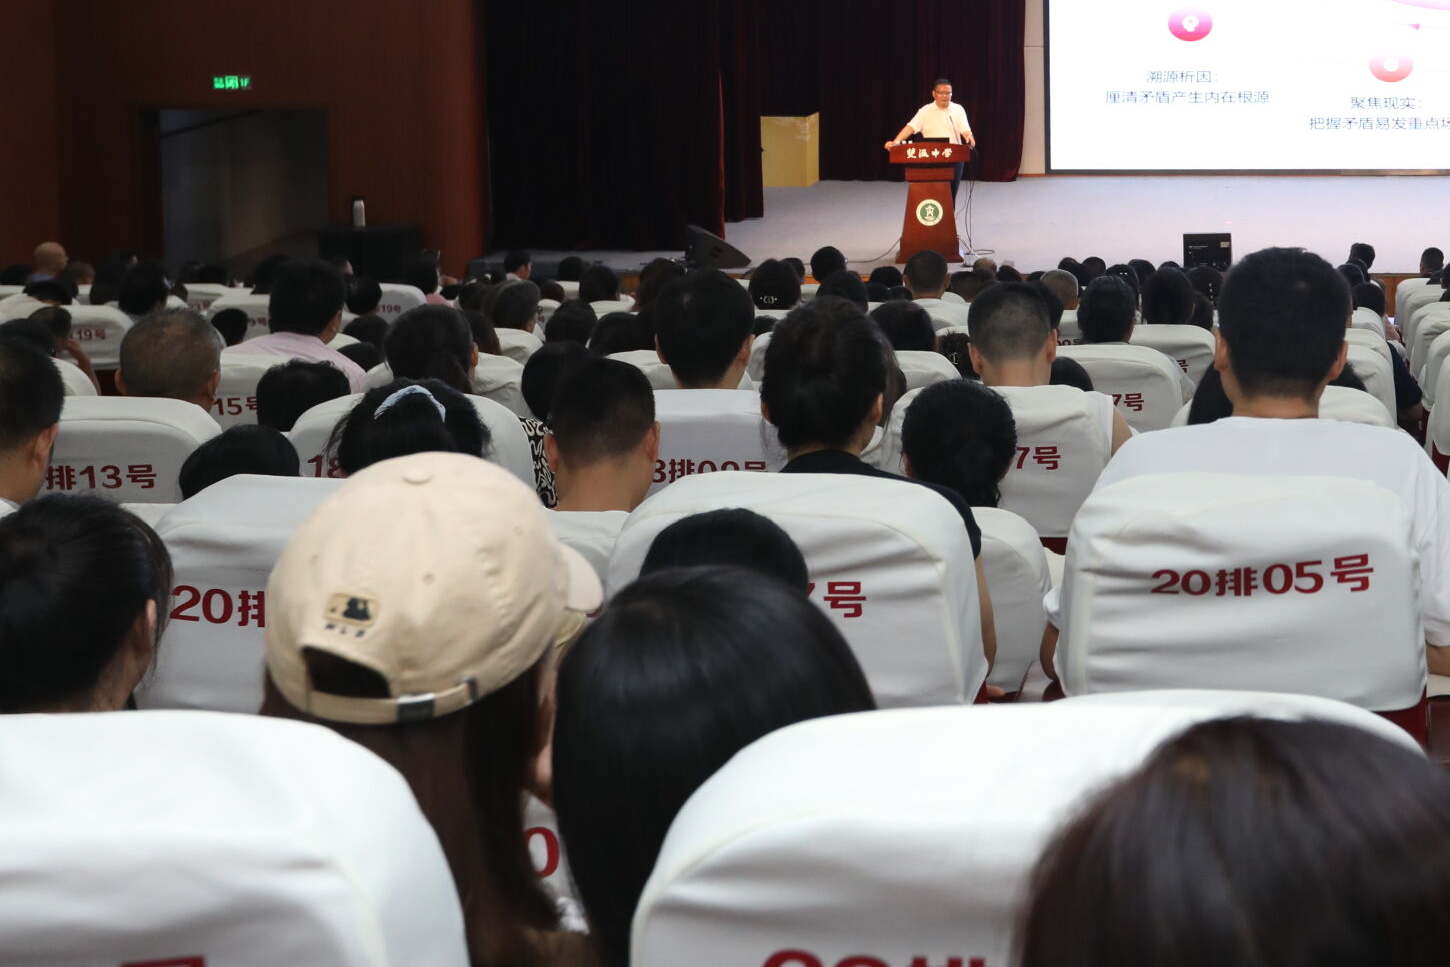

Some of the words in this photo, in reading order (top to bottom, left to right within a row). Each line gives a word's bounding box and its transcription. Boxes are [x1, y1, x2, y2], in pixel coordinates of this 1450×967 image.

[1106, 90, 1270, 104] 厘清矛盾产生内在根源
[1150, 553, 1374, 597] 20排05号
